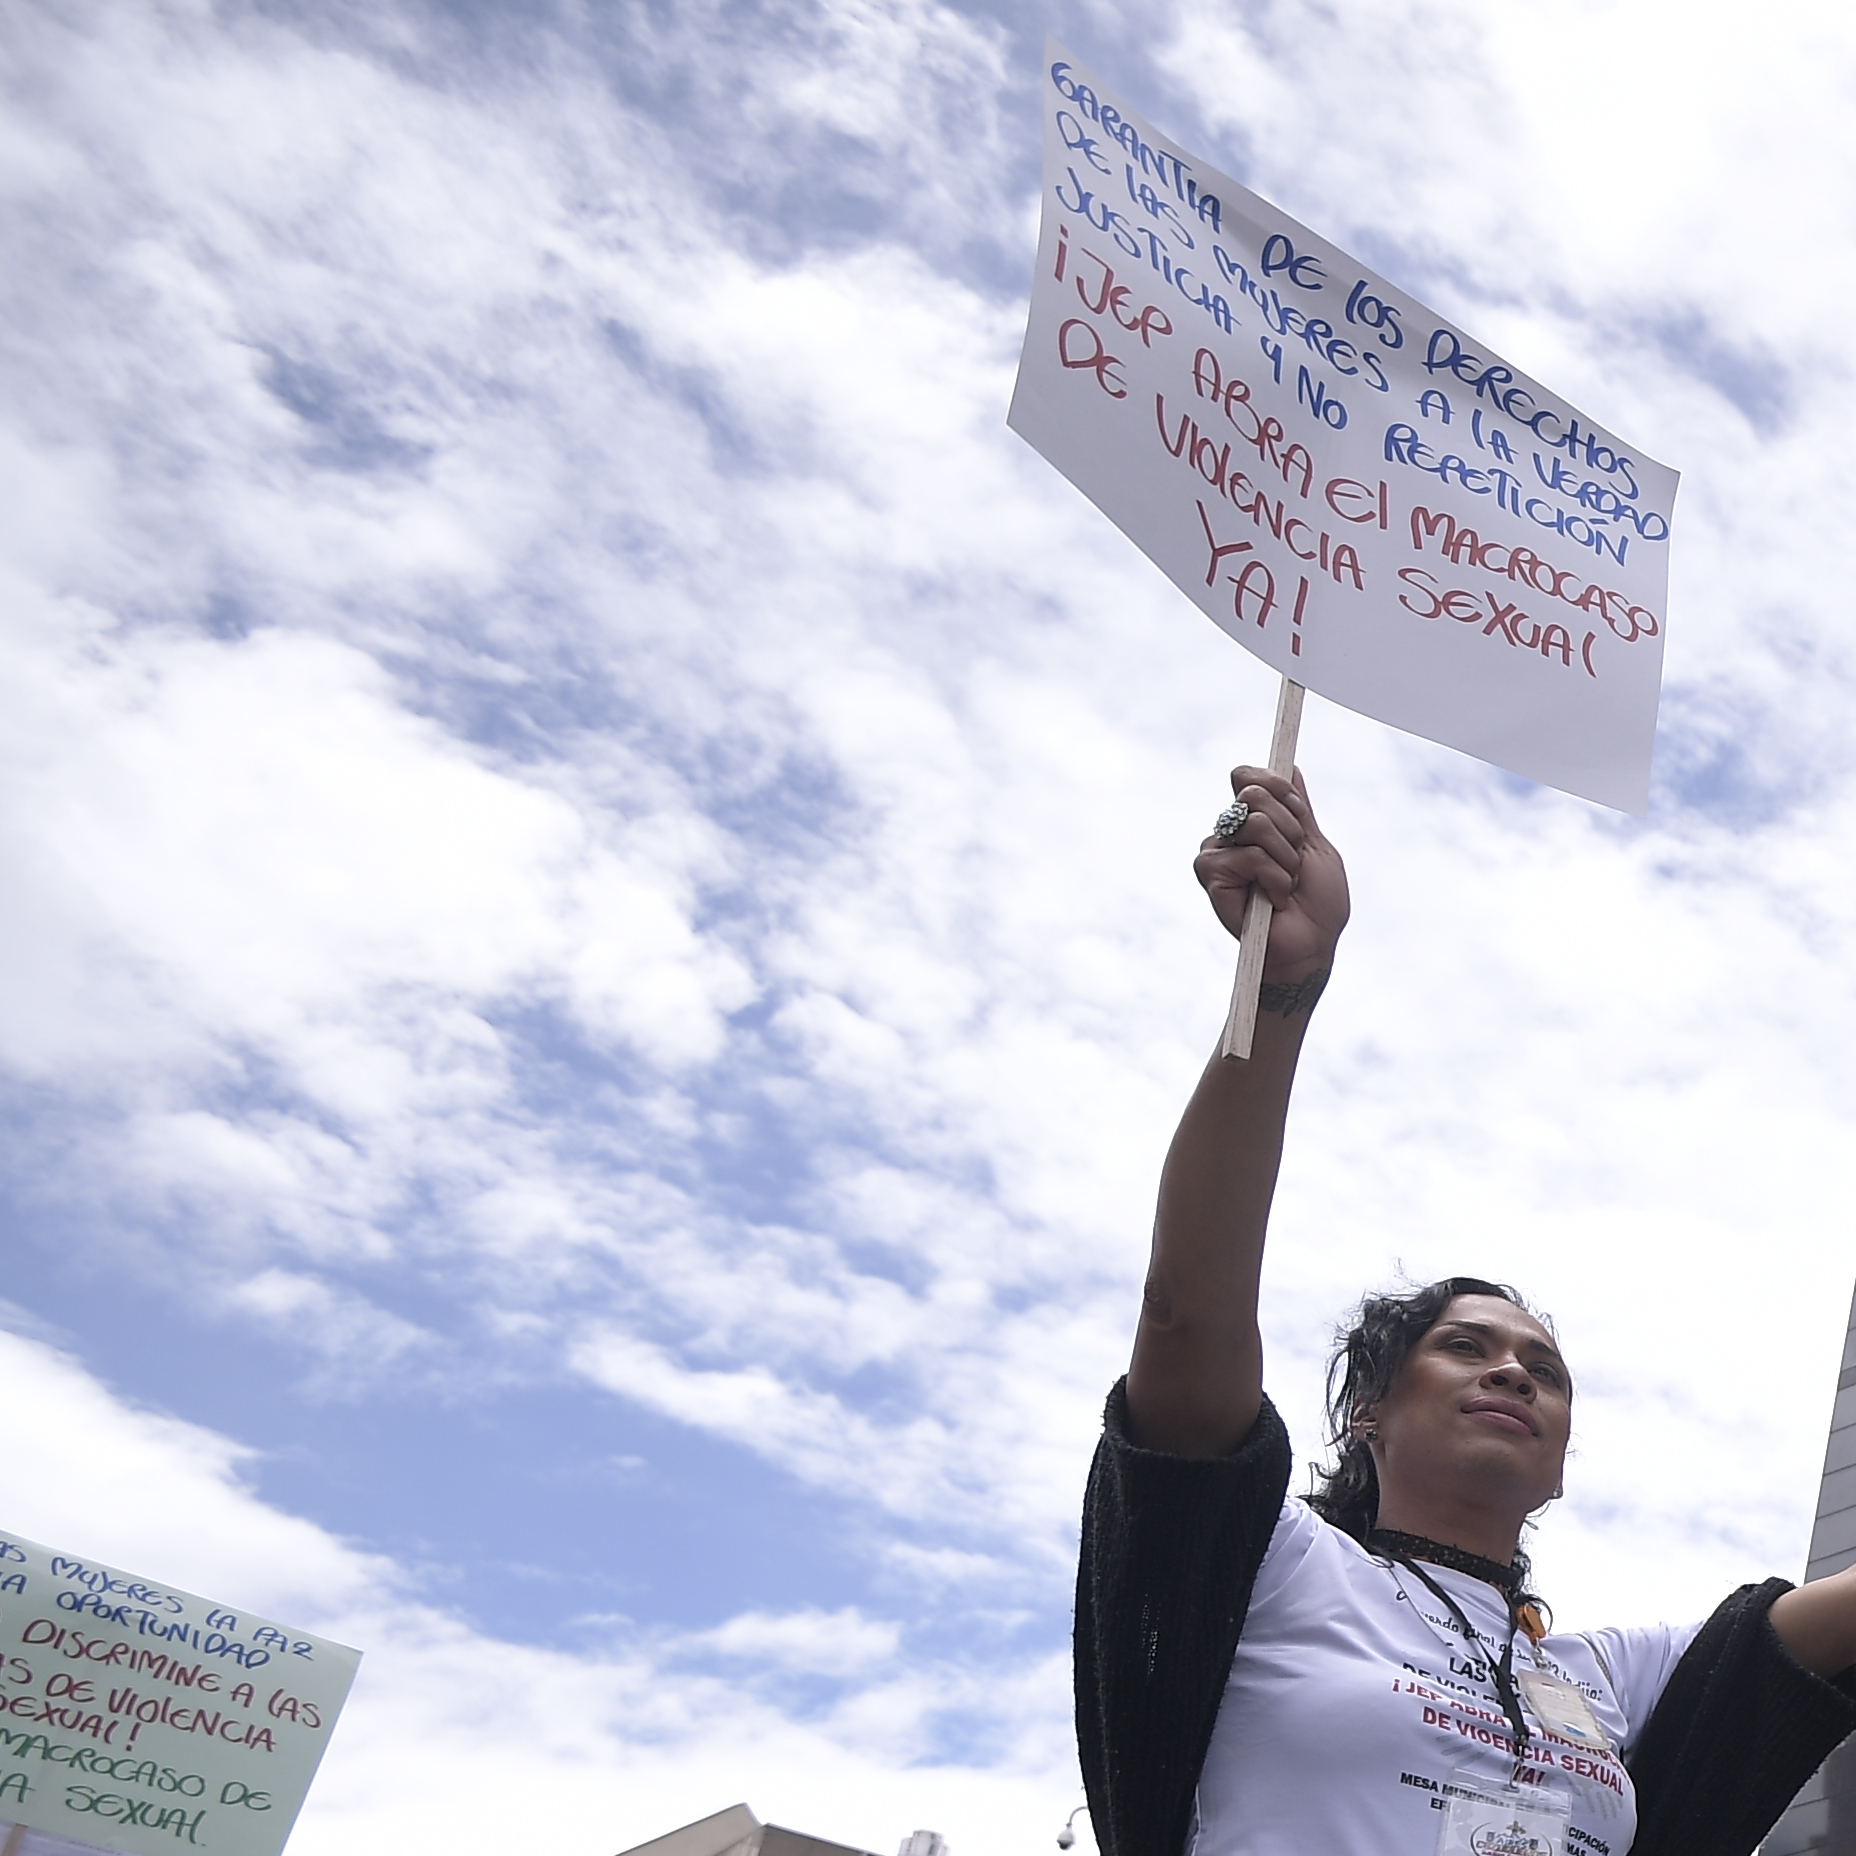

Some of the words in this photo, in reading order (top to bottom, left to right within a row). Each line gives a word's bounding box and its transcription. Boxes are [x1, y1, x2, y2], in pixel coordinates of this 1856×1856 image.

[1051, 62, 1221, 233] GARANTIA
[1260, 234, 1328, 291] DE
[1421, 329, 1640, 499] DERECHOS
[1055, 167, 1241, 335] JUSTICIA
[1259, 335, 1284, 385] Y
[1297, 366, 1348, 430] NO
[1056, 110, 1112, 175] DE
[1126, 164, 1195, 250] LAS
[1213, 245, 1389, 391] MUJERES
[1416, 389, 1455, 424] A
[1472, 408, 1519, 464] LA
[1533, 452, 1670, 541] VERDAD
[1057, 317, 1128, 400] DE
[1156, 393, 1366, 591] VIOLENCIA
[1397, 567, 1598, 678] SEXUAL
[1191, 347, 1313, 498] ABRA
[1325, 478, 1389, 530] EL
[1410, 505, 1660, 643] MACROCASO
[51, 1556, 184, 1615] MUJERES
[206, 1609, 238, 1632] LA
[252, 1626, 314, 1661] PAZ
[56, 1590, 271, 1670] OPORTUNIDAD
[22, 1619, 222, 1693] DISCRIMINE
[230, 1682, 254, 1709] A
[268, 1688, 322, 1729] LAS
[46, 1673, 96, 1703] DE
[107, 1687, 278, 1753] VIOLENCIA
[220, 1781, 272, 1811] DE
[1400, 1772, 1439, 1793] MESA
[1422, 1706, 1451, 1731] DE
[1560, 1755, 1624, 1796] SEXUAL
